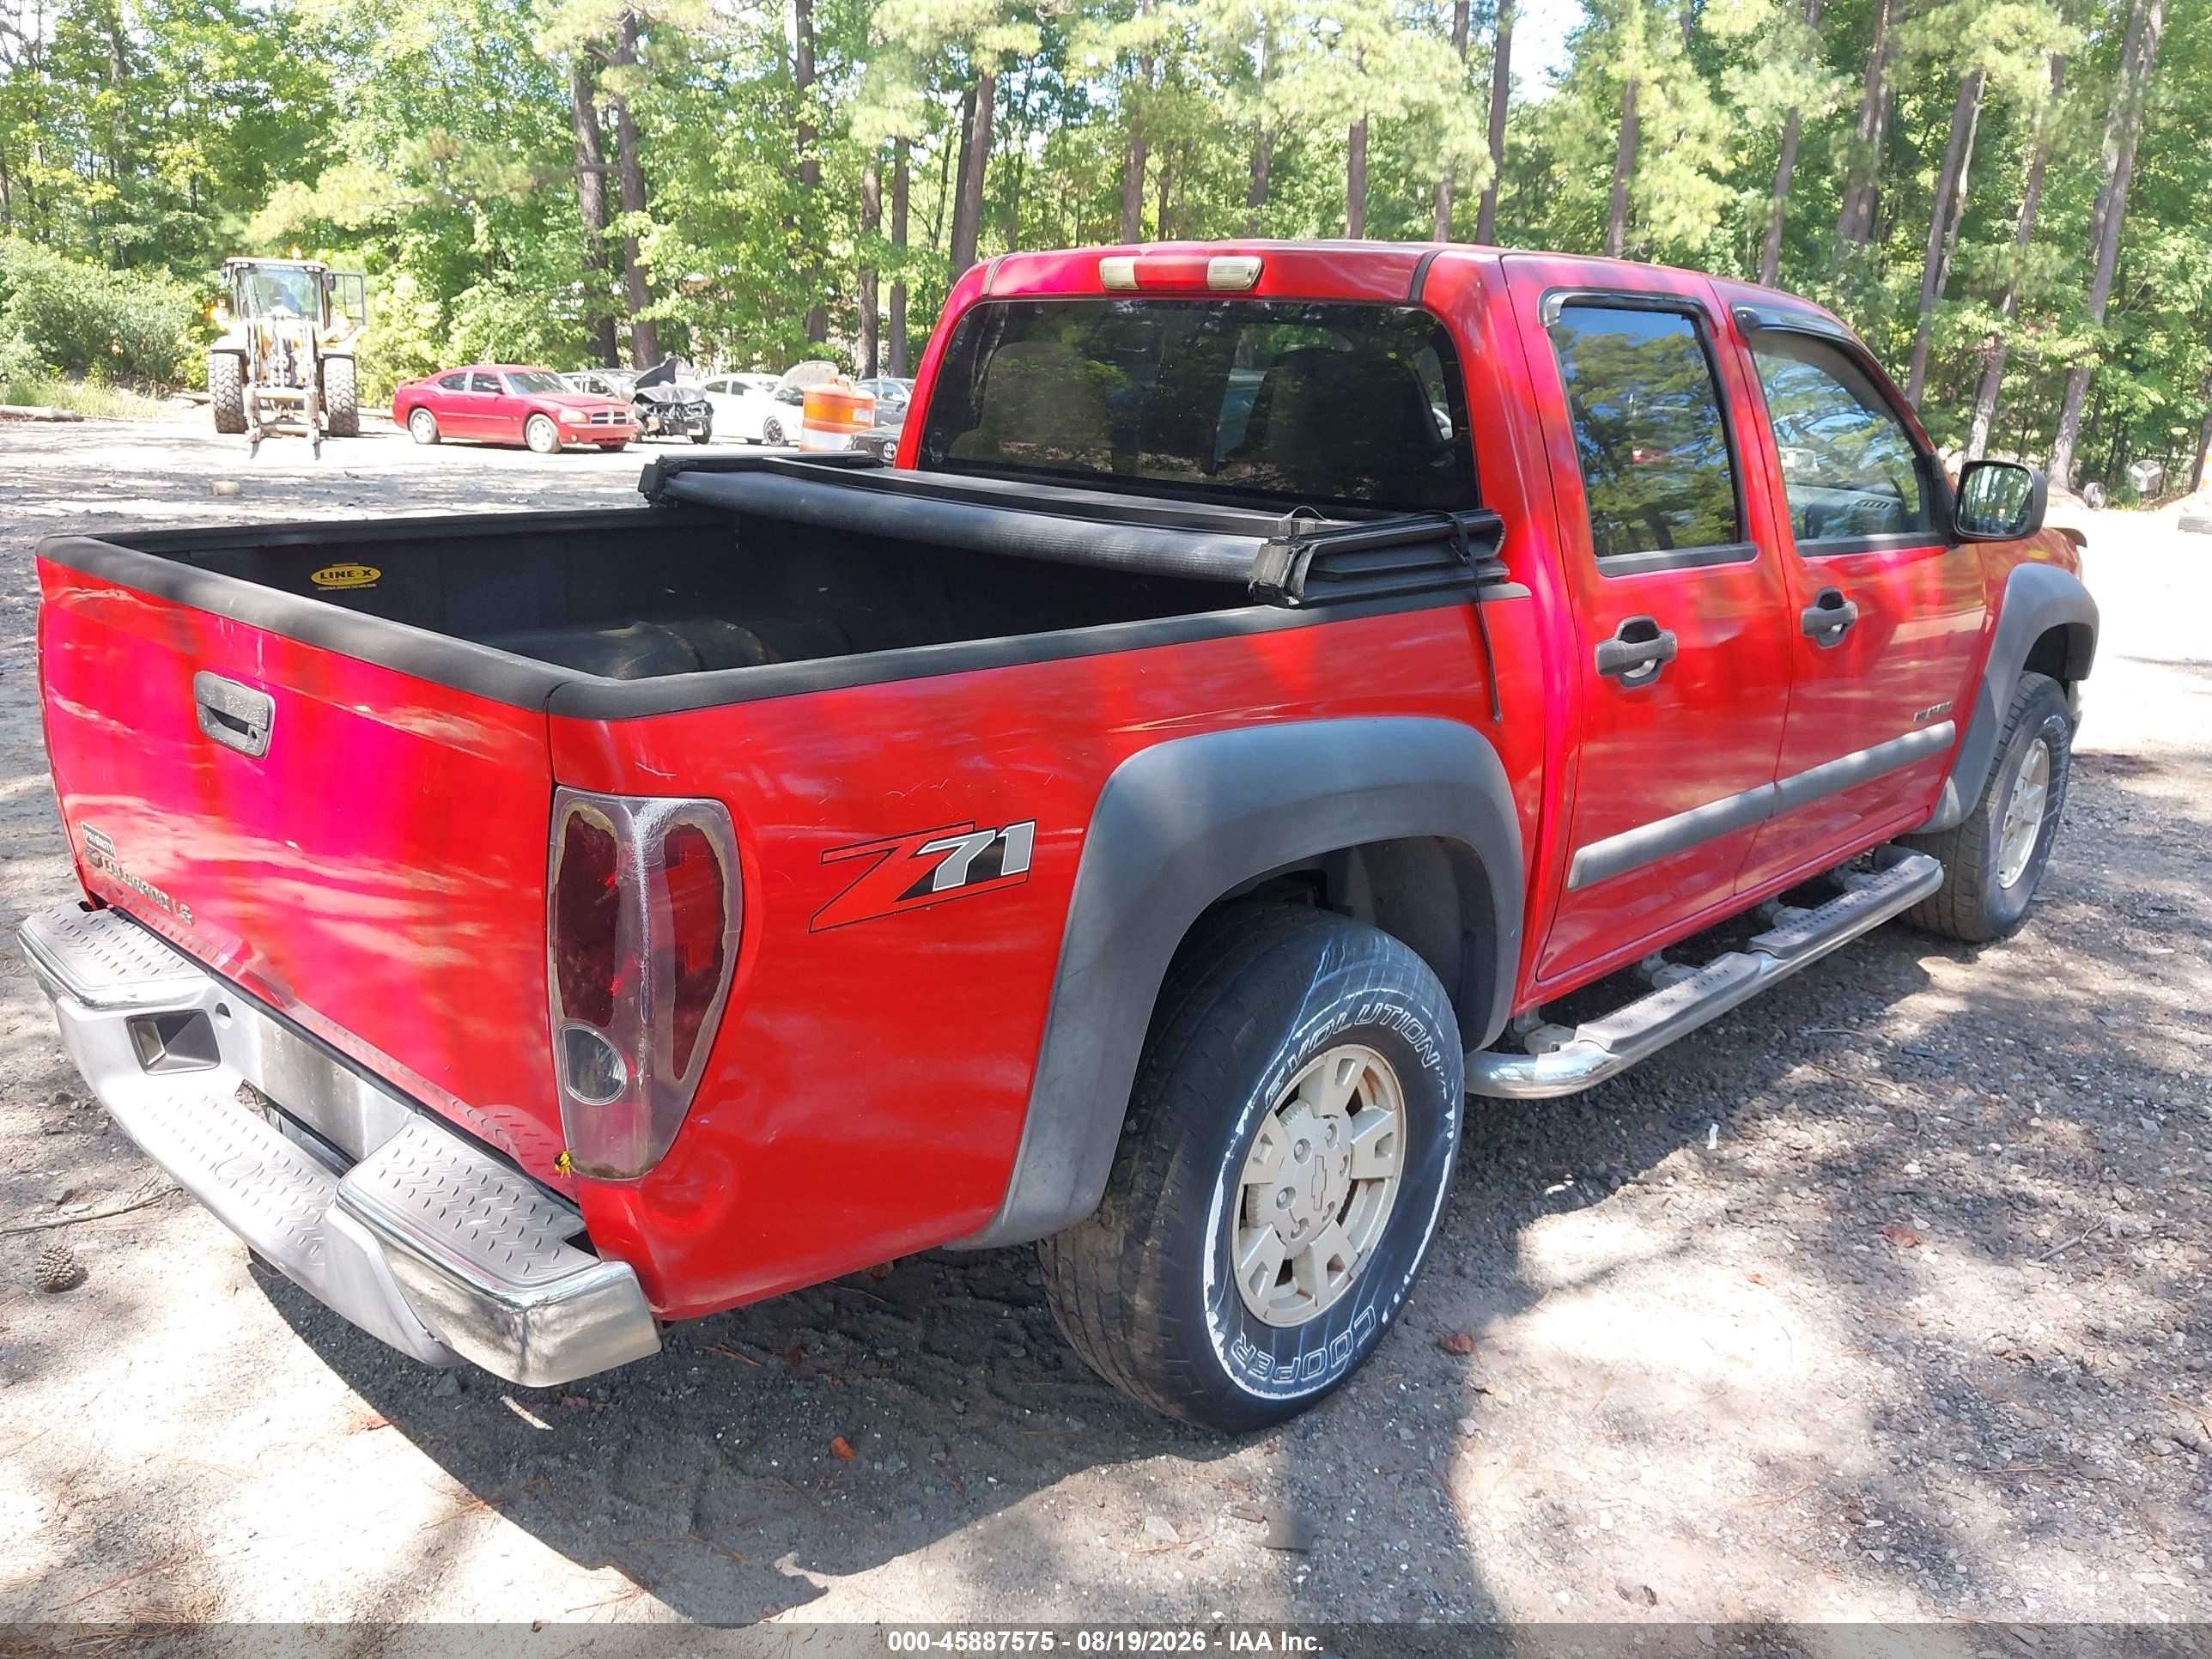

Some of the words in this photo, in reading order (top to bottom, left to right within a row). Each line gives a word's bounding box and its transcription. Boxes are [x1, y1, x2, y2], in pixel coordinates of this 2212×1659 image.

[808, 818, 1037, 933] Z71
[1265, 1002, 1441, 1109] EVOLUTION
[1231, 1304, 1376, 1384] COOPER
